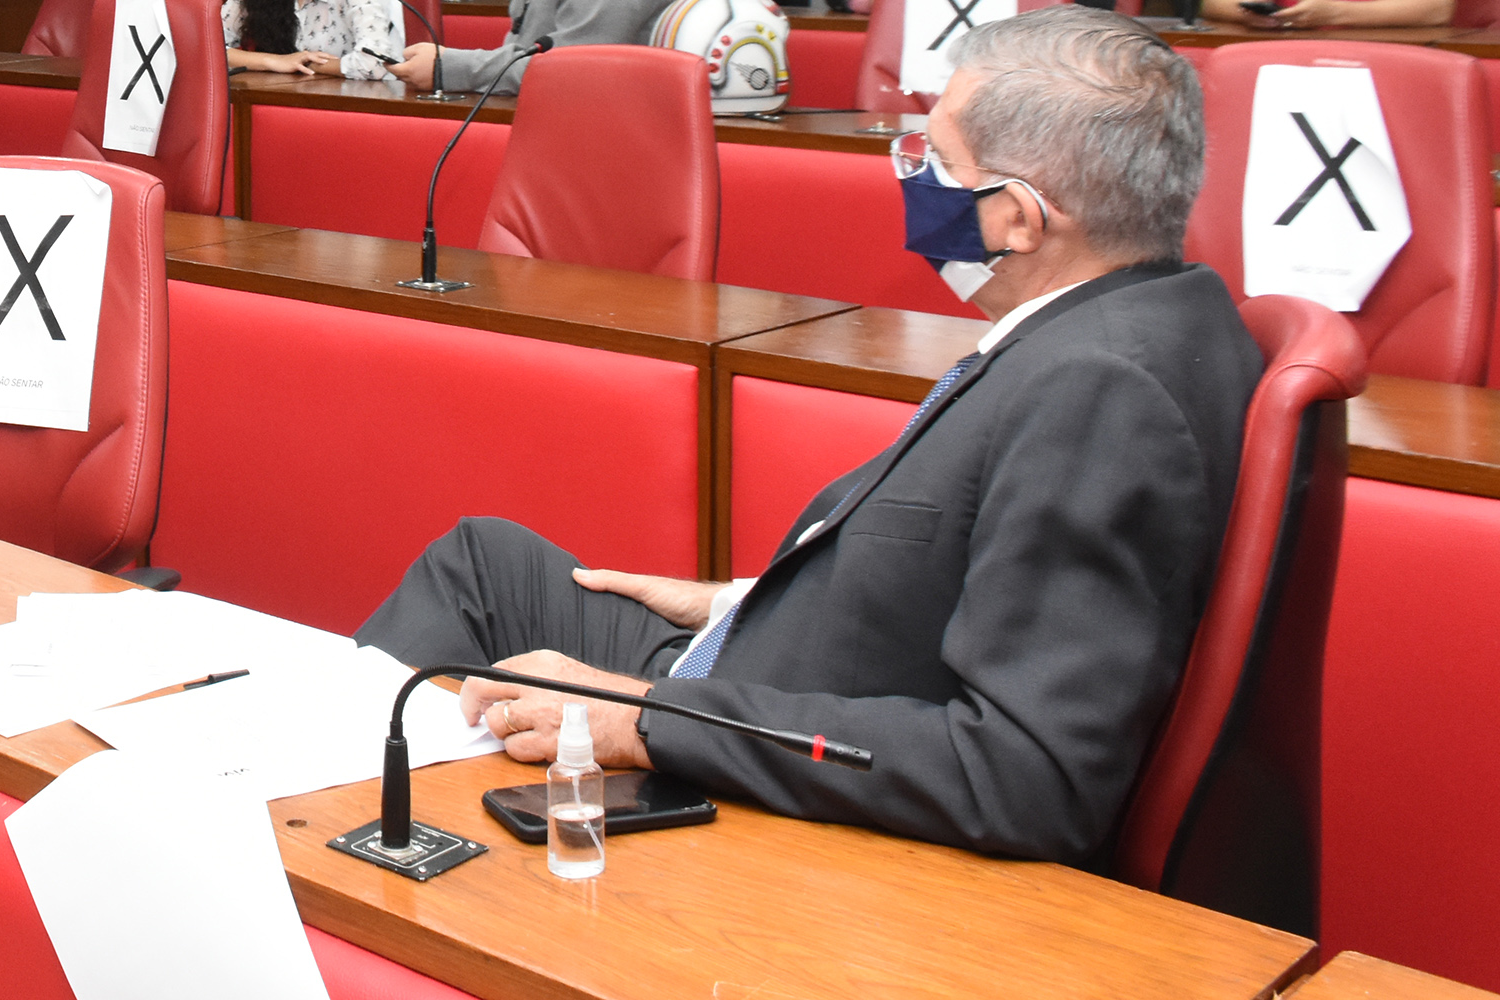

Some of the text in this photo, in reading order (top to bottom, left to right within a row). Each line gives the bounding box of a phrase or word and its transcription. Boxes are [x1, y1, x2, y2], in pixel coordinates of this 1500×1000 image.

[120, 24, 166, 105] X
[1273, 111, 1378, 232] X
[11, 378, 44, 388] SENTAR
